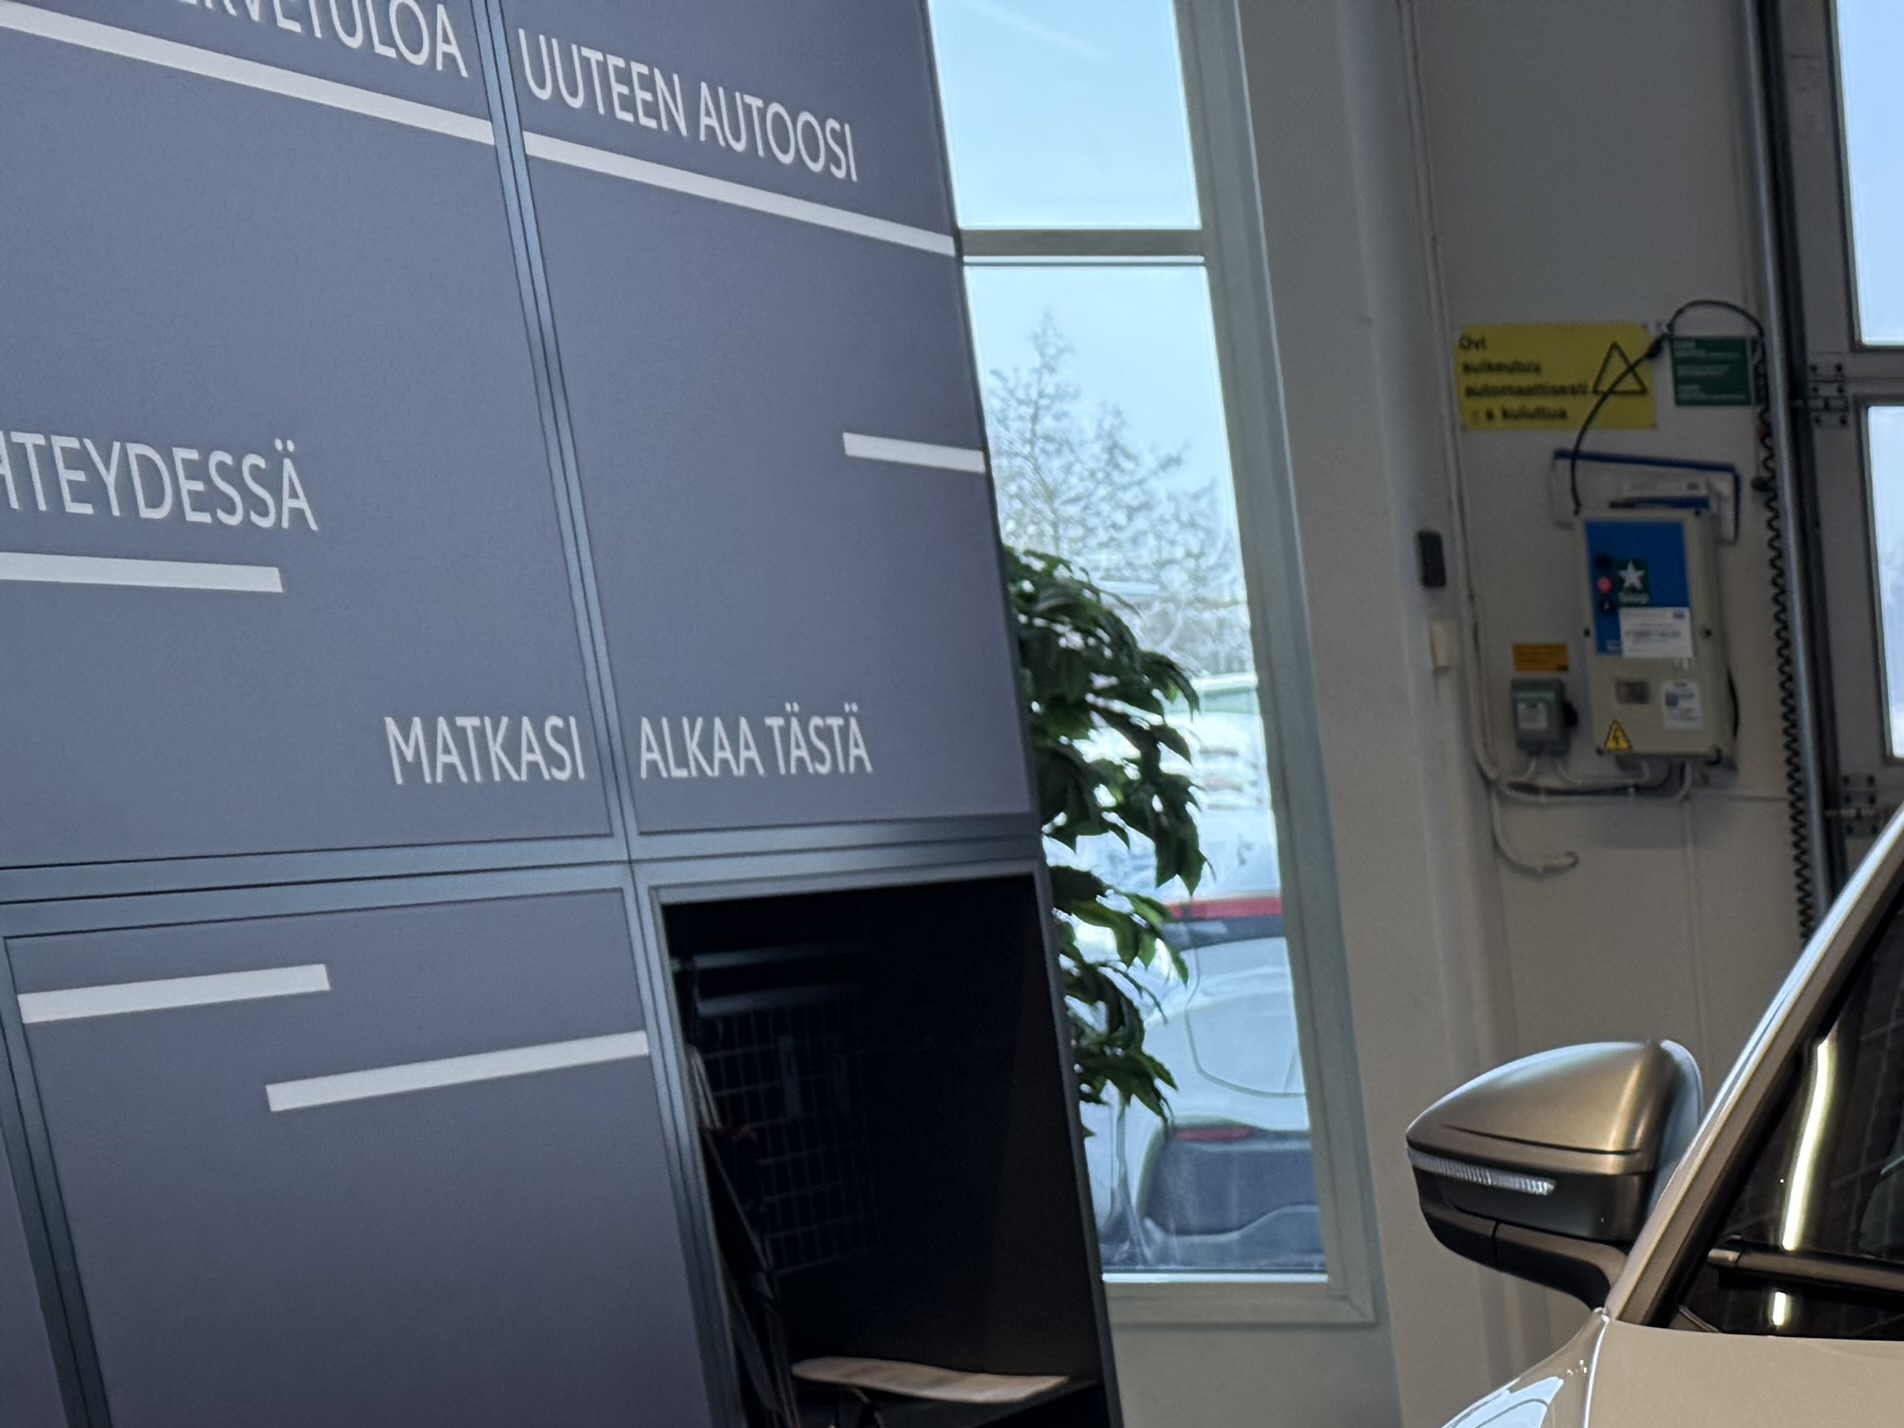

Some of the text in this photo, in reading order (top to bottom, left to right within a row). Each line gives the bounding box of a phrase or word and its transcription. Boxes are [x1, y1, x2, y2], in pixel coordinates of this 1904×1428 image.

[519, 28, 689, 137] UUTEEN
[697, 81, 858, 182] AUTOOSI
[384, 702, 872, 785] MATKASI ALKAA TÄSTÄ
